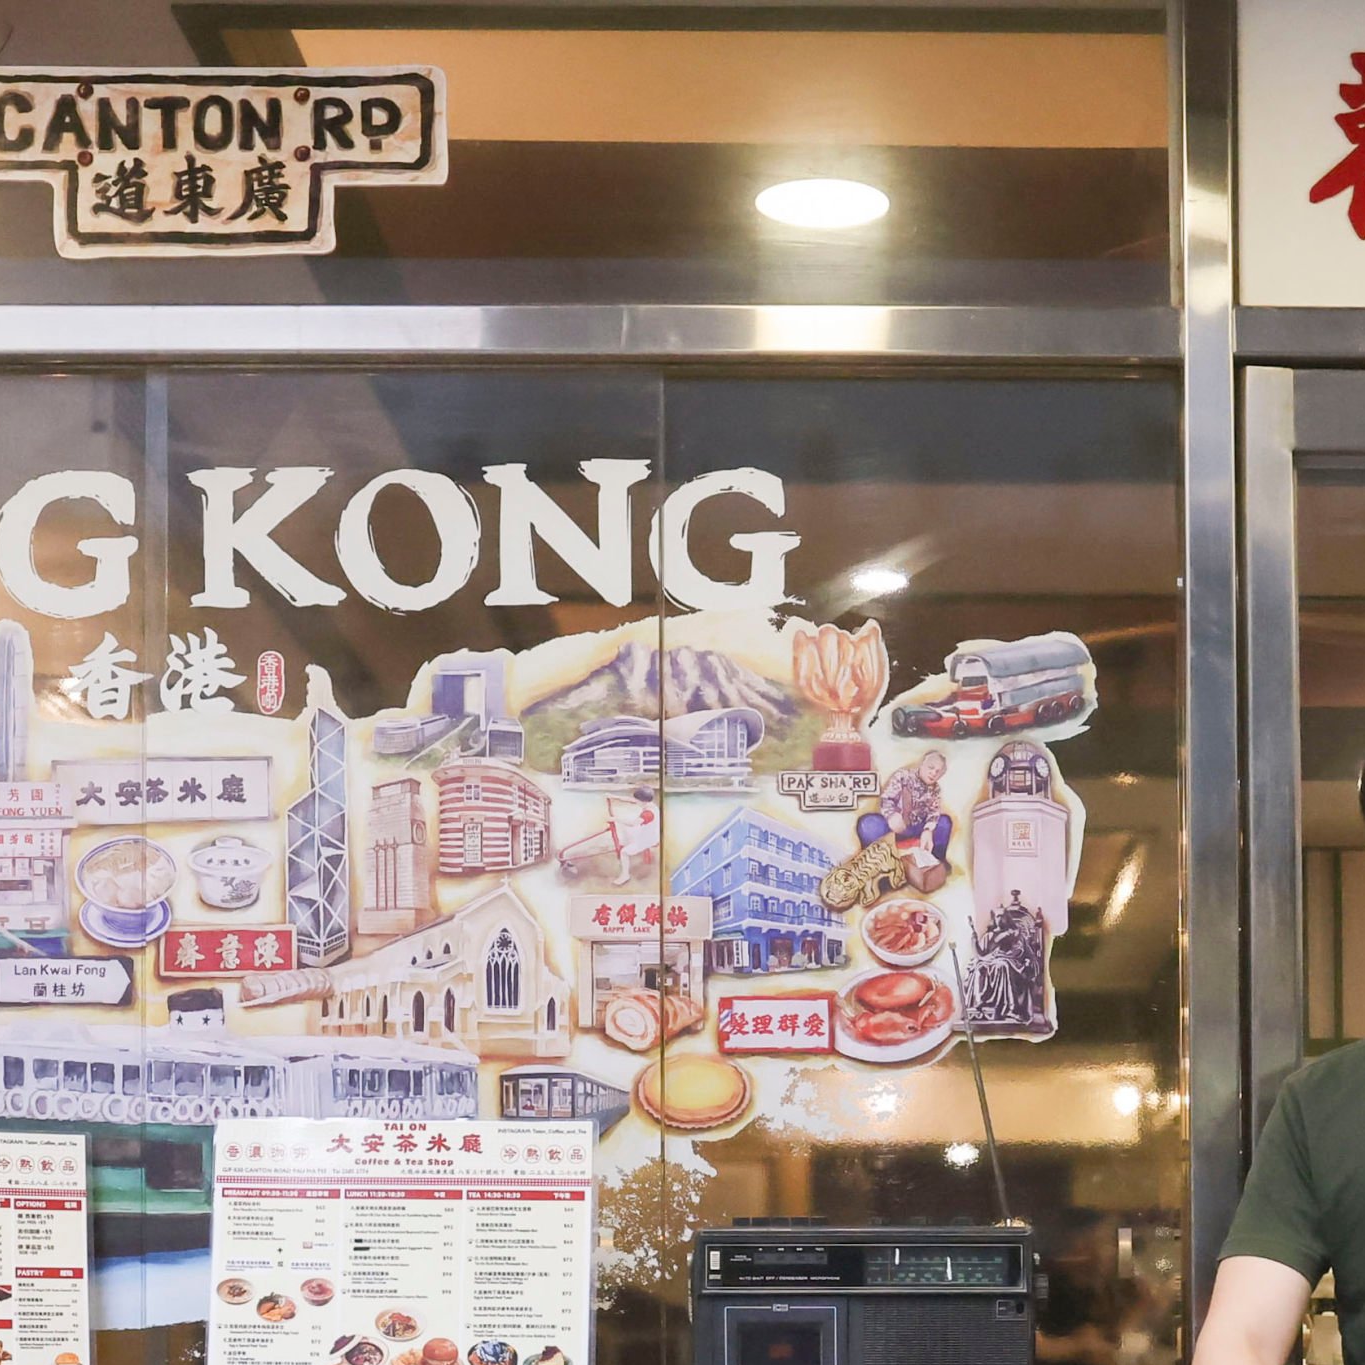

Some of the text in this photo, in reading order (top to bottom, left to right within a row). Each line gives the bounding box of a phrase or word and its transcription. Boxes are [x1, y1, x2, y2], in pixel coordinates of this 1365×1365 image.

[190, 456, 803, 615] KONG
[67, 626, 249, 719] 香港
[787, 775, 815, 789] PAK
[820, 776, 847, 789] SHA
[31, 807, 63, 817] YUEN
[13, 964, 107, 978] Lan Kwai Fong
[33, 982, 86, 998] 蘭桂坊
[383, 1122, 427, 1132] TAI ON
[354, 1158, 455, 1168] Coffee & Tea Shop
